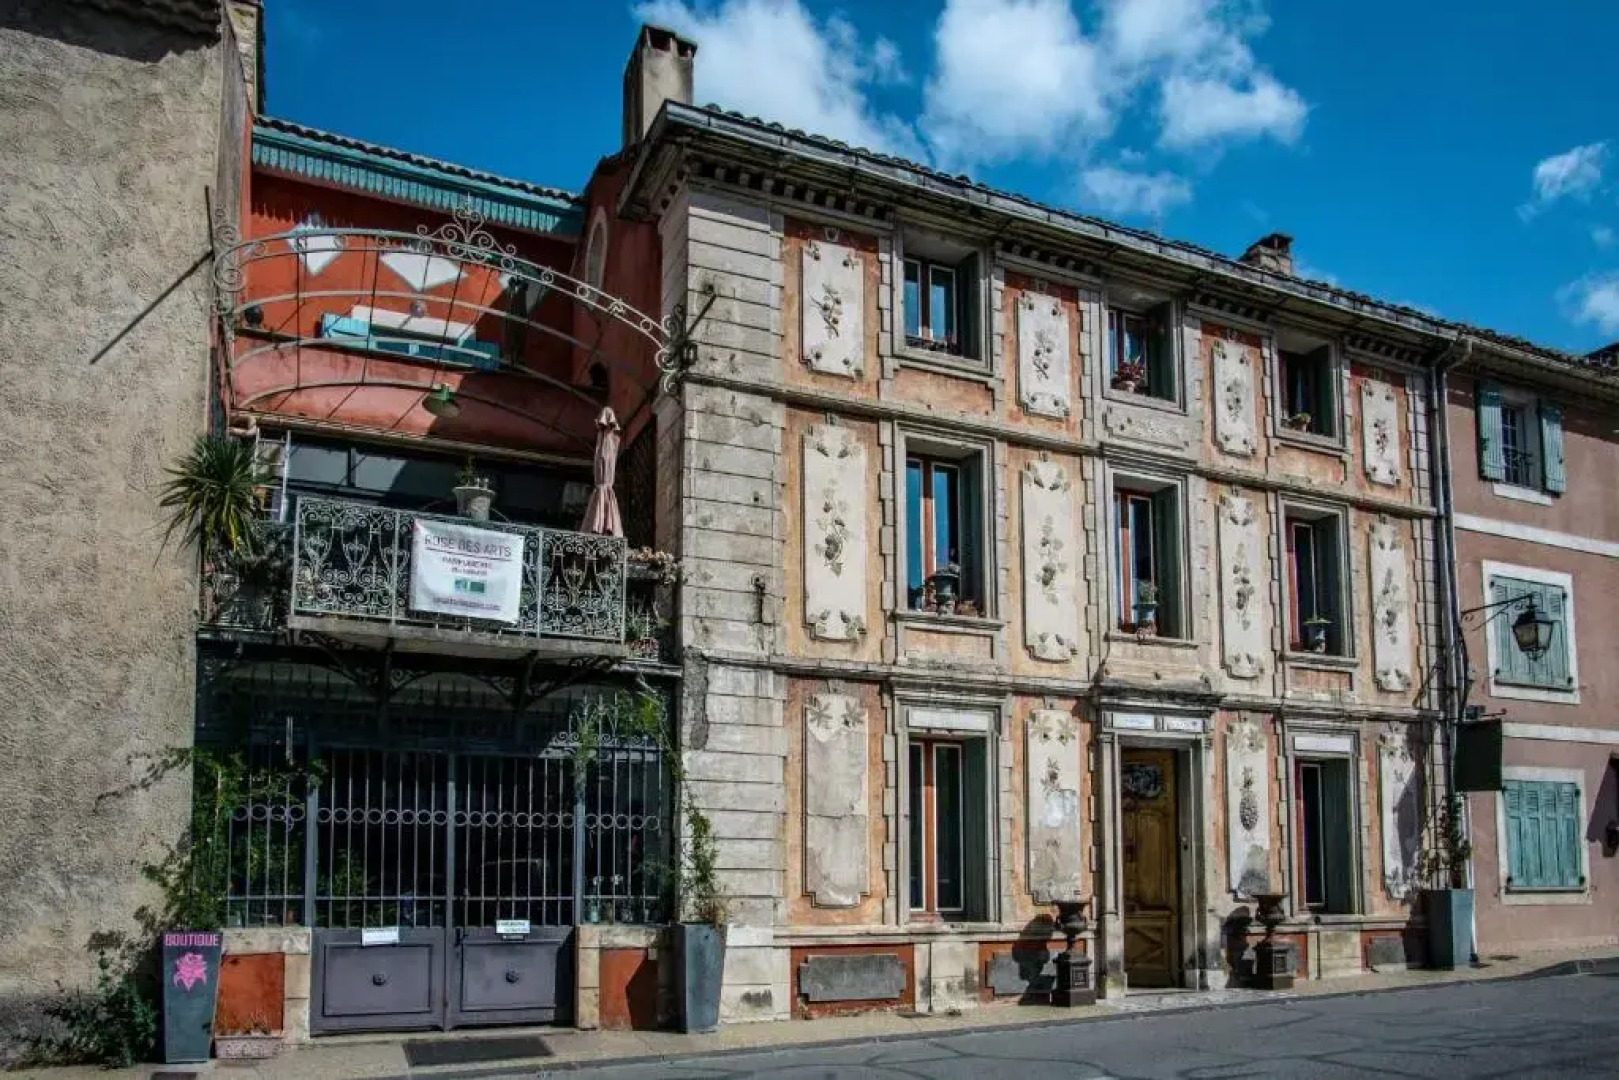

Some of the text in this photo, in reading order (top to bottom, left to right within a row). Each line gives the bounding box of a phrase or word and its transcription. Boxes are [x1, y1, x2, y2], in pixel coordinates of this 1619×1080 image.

[424, 536, 512, 557] ROSE DES ARTS
[165, 934, 219, 947] BOUTIQUE
